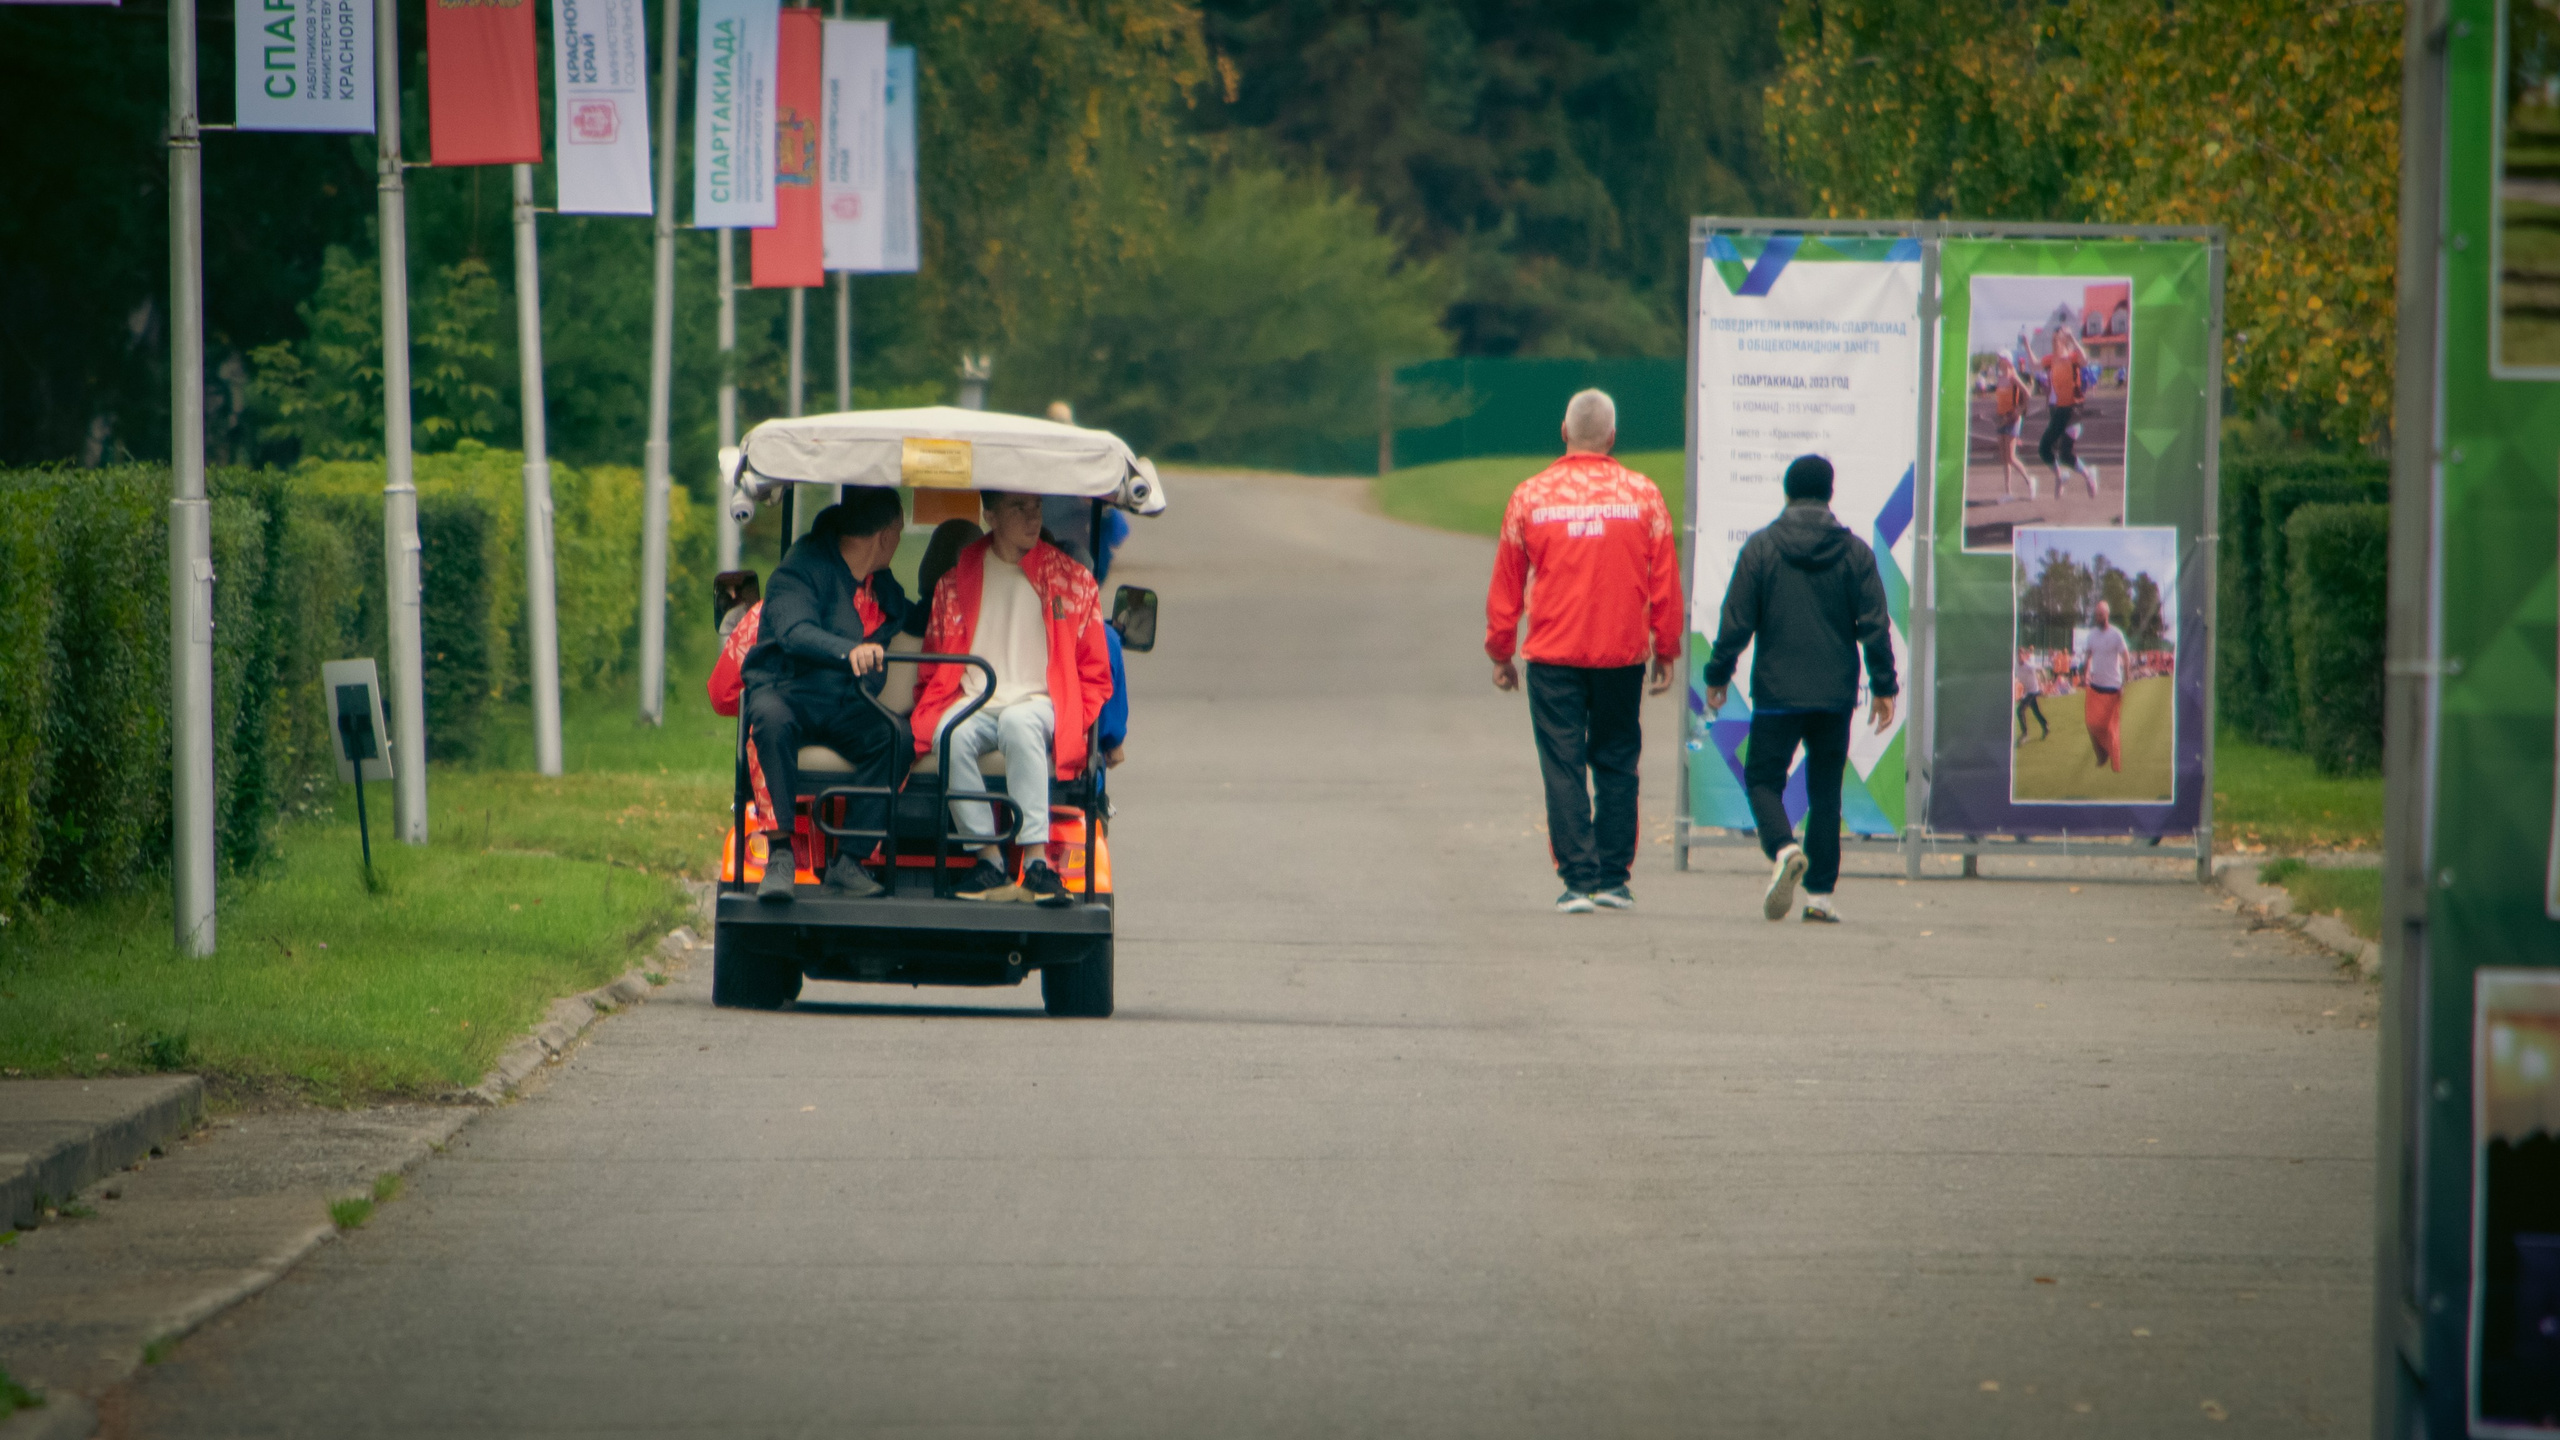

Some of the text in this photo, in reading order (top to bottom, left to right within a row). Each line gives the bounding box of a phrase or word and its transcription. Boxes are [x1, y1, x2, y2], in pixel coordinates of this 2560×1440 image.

[306, 16, 317, 100] РАБОТНИКОВ
[579, 33, 598, 84] КРАЙ
[710, 18, 737, 204] СПАРТАКИАДА
[1710, 318, 1780, 333] ПОБЕДИТЕЛИ
[1792, 319, 1839, 334] ПРИЗЁРЫ
[1842, 321, 1906, 336] СПАРТАКИАД
[1738, 339, 1745, 351] В
[1747, 338, 1840, 354] ОБЩЕКОМАНДНОМ
[1737, 374, 1807, 389] СПАРТАКИАДА,
[1809, 376, 1829, 389] 2023
[1831, 376, 1849, 390] ГОД
[1742, 400, 1779, 415] КОМАНД
